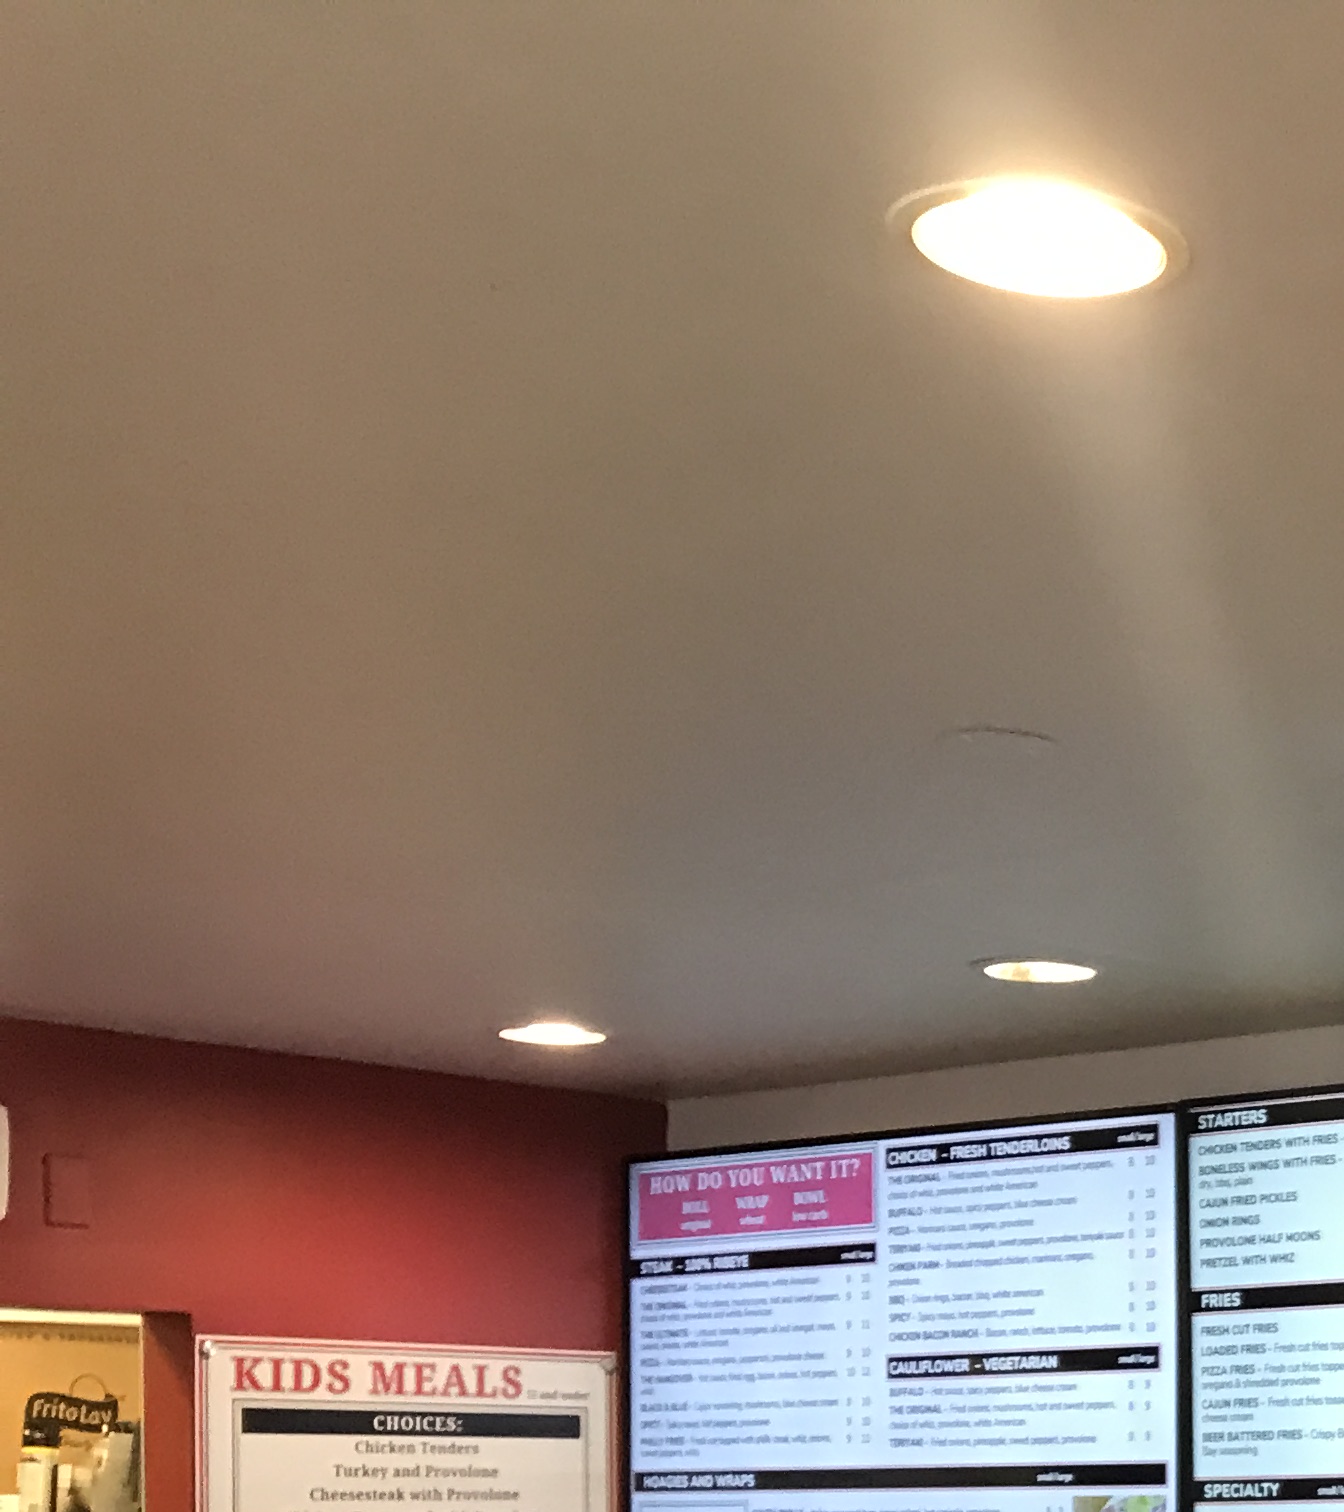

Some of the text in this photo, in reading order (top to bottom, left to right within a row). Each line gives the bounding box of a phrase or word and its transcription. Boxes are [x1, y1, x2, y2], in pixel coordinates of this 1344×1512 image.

[1198, 1109, 1268, 1129] STARTERS
[950, 1144, 987, 1160] FRESH
[989, 1136, 1071, 1156] TENDERLOINS
[1198, 1145, 1237, 1156] CHICKEN
[1240, 1138, 1282, 1152] TENDERS
[1285, 1136, 1310, 1147] WITH
[1312, 1133, 1338, 1145] FRIES
[1198, 1162, 1245, 1176] BONELESS
[1248, 1159, 1280, 1171] WINGS
[1282, 1156, 1307, 1168] WITH
[1310, 1154, 1336, 1166] FRIES
[650, 1158, 860, 1195] HOW DO YOU WANT IT?
[1199, 1191, 1298, 1209] CAJUN FRIED PICKLES
[1231, 1214, 1261, 1226] RINGS
[1199, 1230, 1321, 1249] PROVOLONE HALF MOONS
[1200, 1252, 1295, 1269] PRETZEL WITH WHIZ
[1201, 1292, 1241, 1308] FRIES
[1200, 1325, 1229, 1337] FRESH
[1232, 1323, 1250, 1335] CUT
[1253, 1322, 1279, 1334] FRIES
[1201, 1345, 1238, 1357] LOADED
[1240, 1343, 1267, 1355] FRIES
[889, 1355, 1059, 1375] CAULIFLOWER VEGETARIAN
[1201, 1365, 1227, 1376] PIZZA
[1229, 1364, 1255, 1375] FRIES
[231, 1356, 523, 1399] KIDS MEALS
[1233, 1397, 1259, 1408] FRIES
[373, 1414, 464, 1432] CHOICES:
[1227, 1430, 1275, 1442] BATTERED
[1276, 1429, 1303, 1441] FRIES
[354, 1440, 480, 1455] Chicken Tenders
[334, 1464, 499, 1480] Turkey and Provolone
[309, 1487, 520, 1501] Cheesesteak with Provolone
[1203, 1482, 1281, 1499] SPECIALTY
